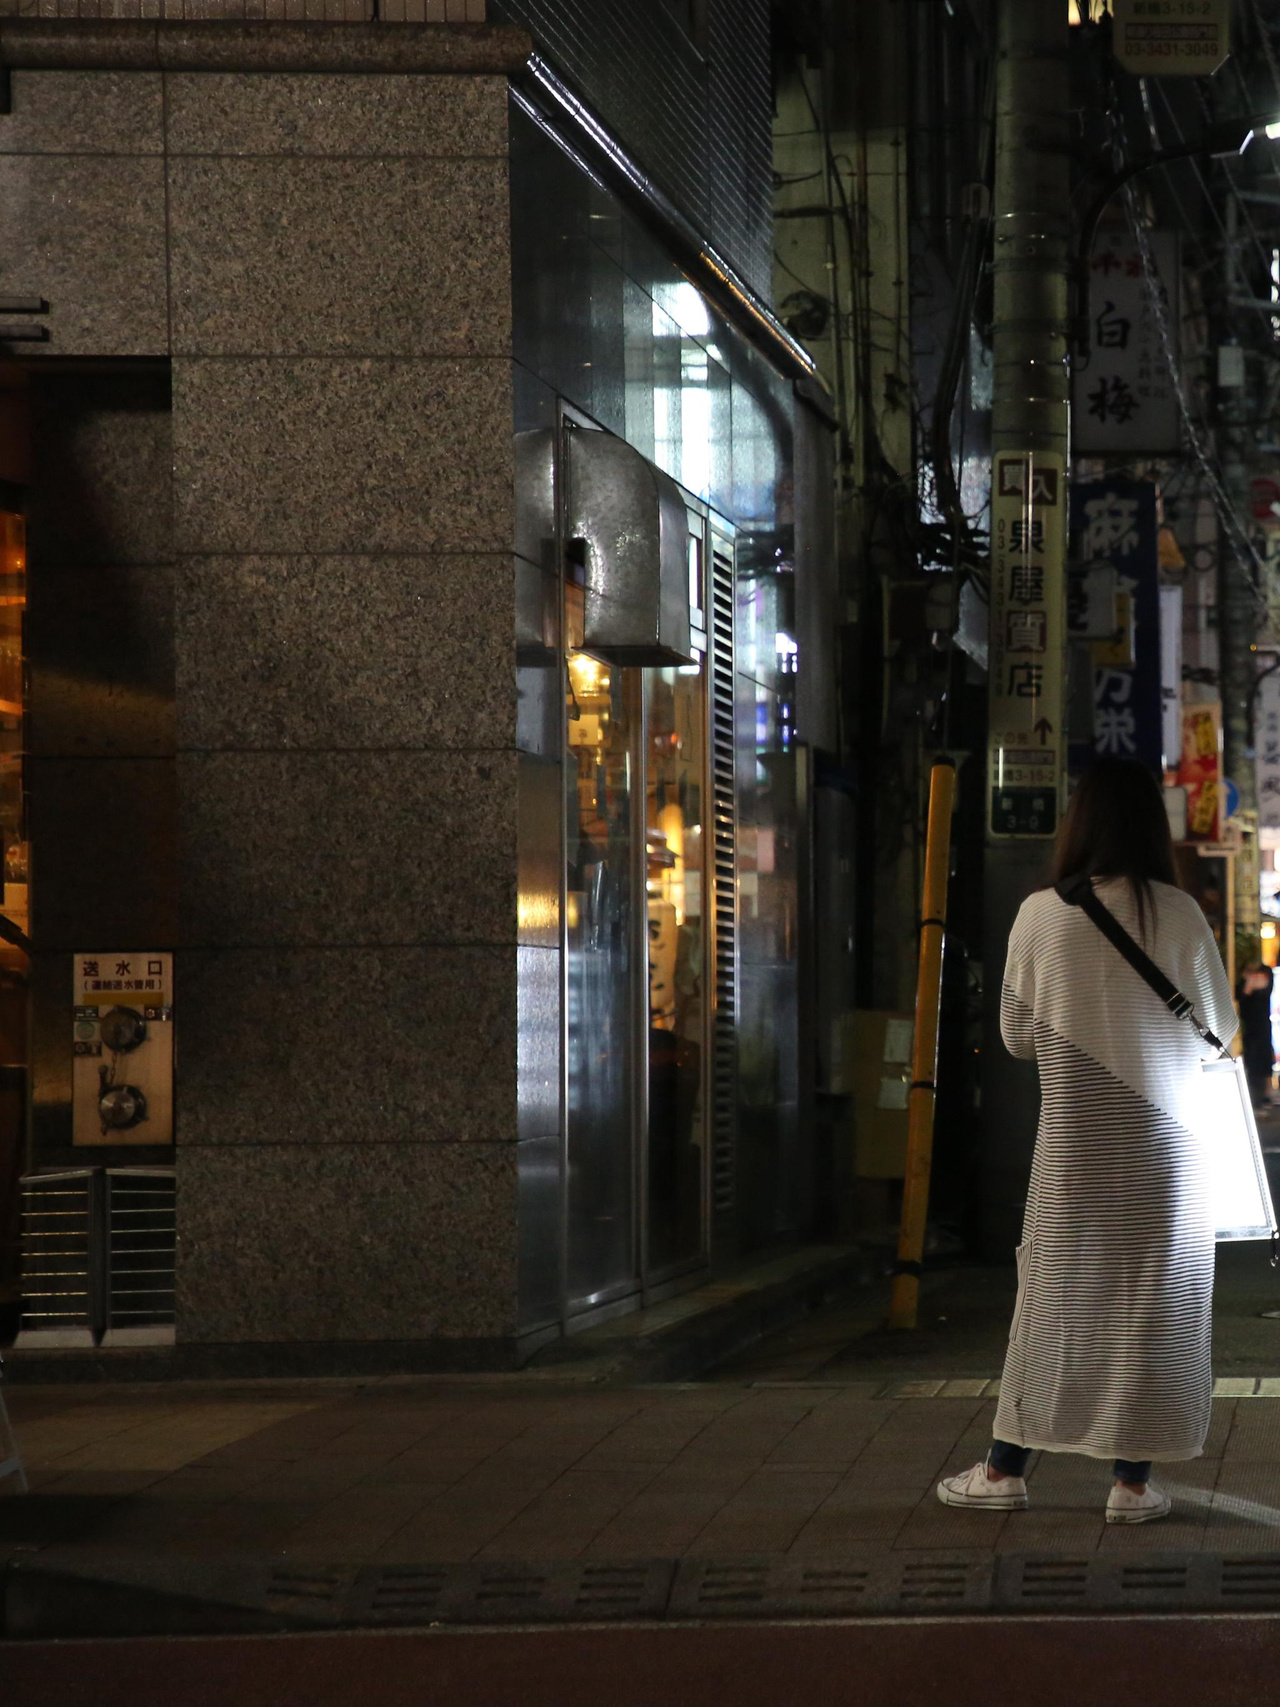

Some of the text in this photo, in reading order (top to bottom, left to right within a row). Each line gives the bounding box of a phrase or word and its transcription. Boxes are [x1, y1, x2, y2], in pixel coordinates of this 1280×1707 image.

[1088, 301, 1138, 424] 白梅
[1008, 519, 1046, 698] 泉屋質店
[83, 960, 162, 977] 送水口
